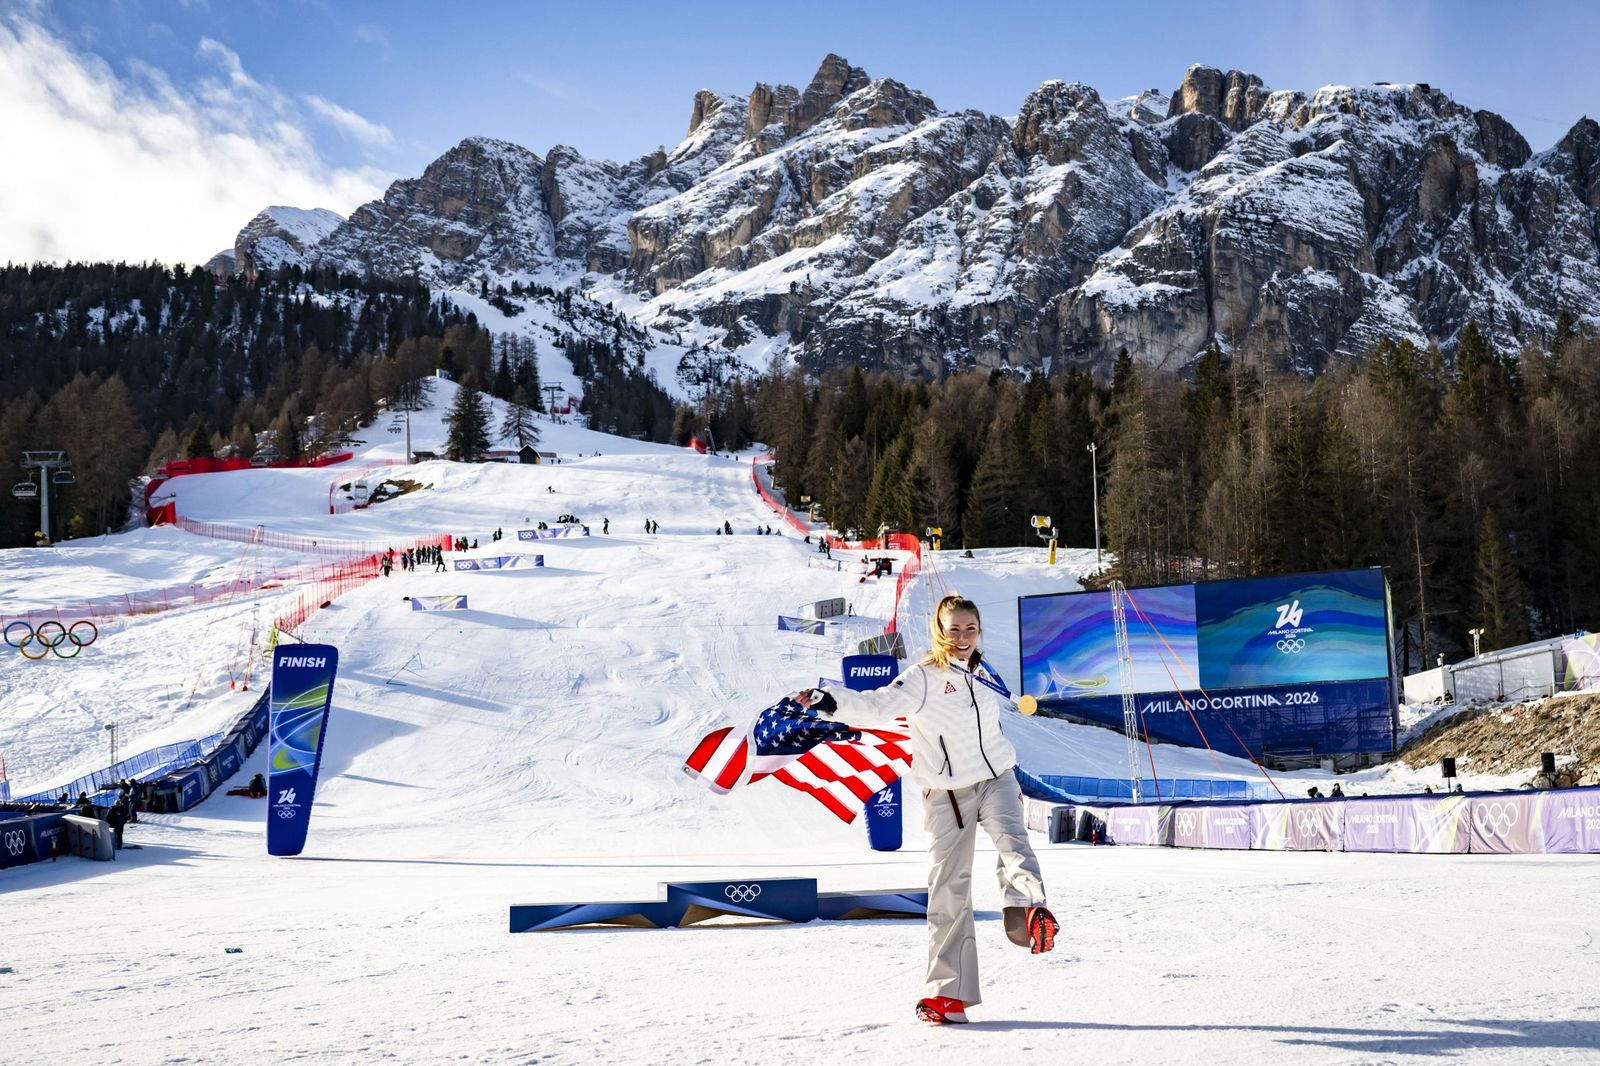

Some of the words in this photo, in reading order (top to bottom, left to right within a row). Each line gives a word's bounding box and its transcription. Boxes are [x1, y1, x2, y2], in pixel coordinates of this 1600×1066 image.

[1276, 600, 1303, 628] 26
[279, 656, 326, 668] FINISH
[850, 666, 891, 677] FINISH
[1141, 699, 1208, 714] MILANO
[1211, 694, 1282, 710] CORTINA
[1285, 691, 1319, 706] 2026
[278, 787, 296, 804] 26
[878, 788, 894, 803] 26
[1349, 814, 1372, 824] MILANO
[1557, 806, 1594, 819] MILANO
